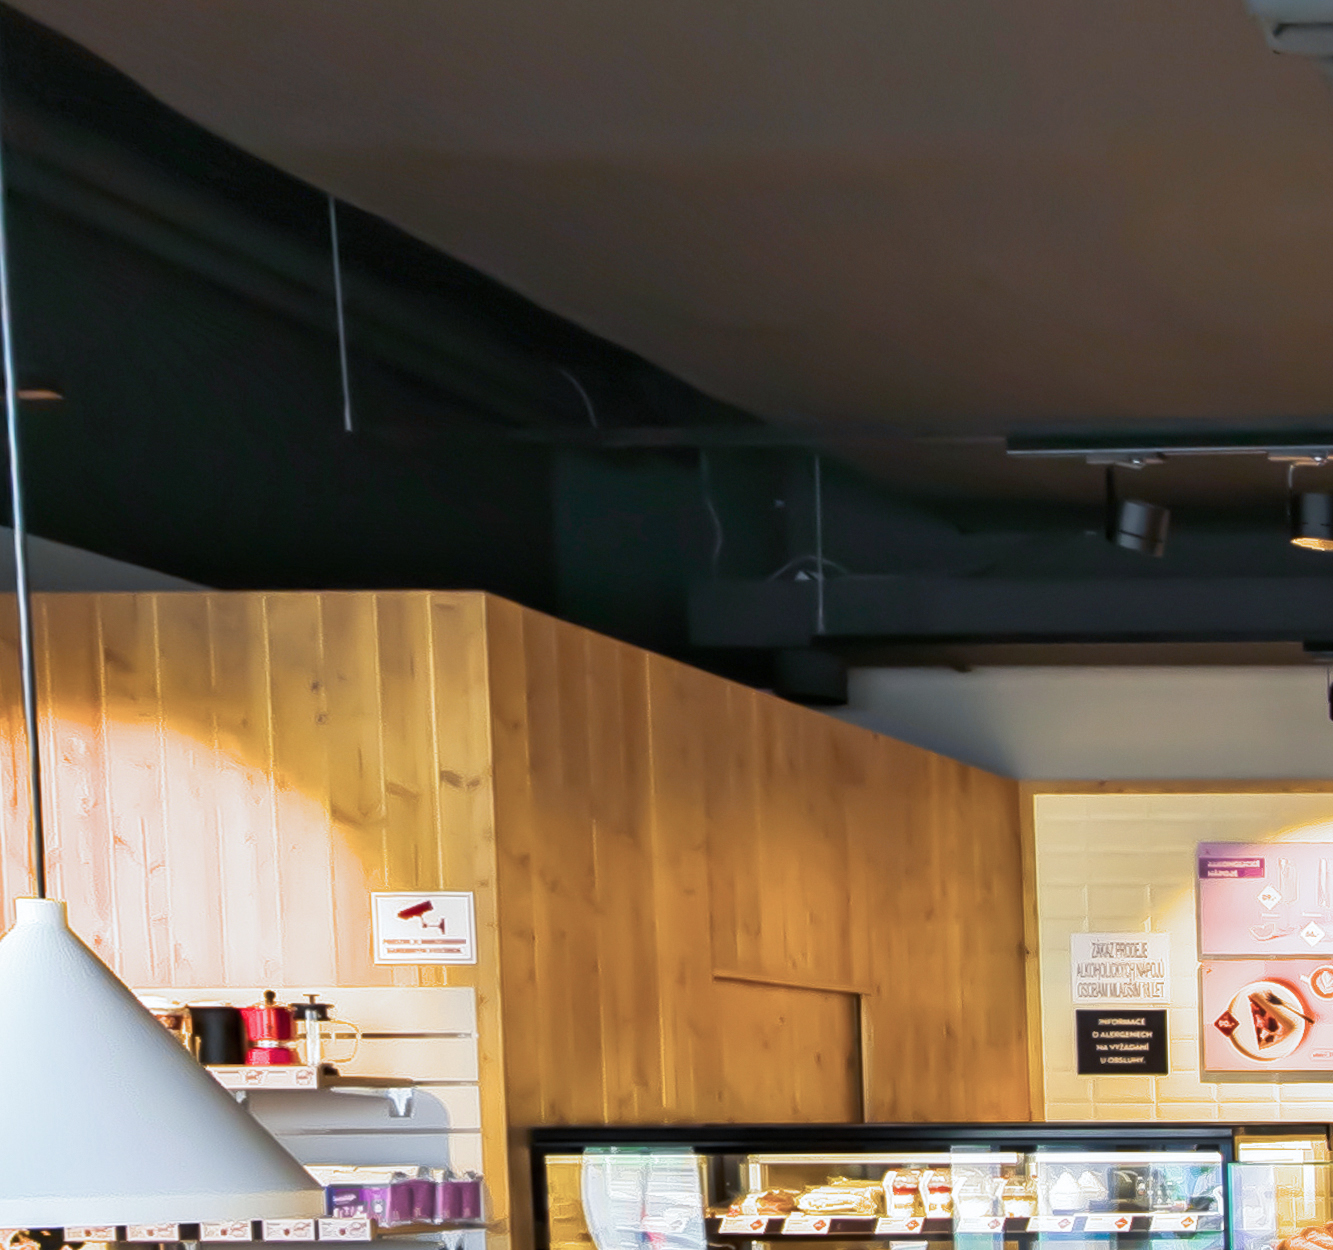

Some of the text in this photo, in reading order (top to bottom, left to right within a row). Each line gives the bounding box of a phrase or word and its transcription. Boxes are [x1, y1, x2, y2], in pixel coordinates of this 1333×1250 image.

[1091, 940, 1148, 958] ZÁKAZ PRODEJE
[1135, 959, 1164, 978] NÁPOJŮ
[1151, 982, 1164, 998] LET
[1100, 1031, 1153, 1039] ALERGENECH
[1096, 1042, 1149, 1051] NA VYŽÁDÁNÍ
[1100, 1056, 1146, 1064] U OBSLUHY.
